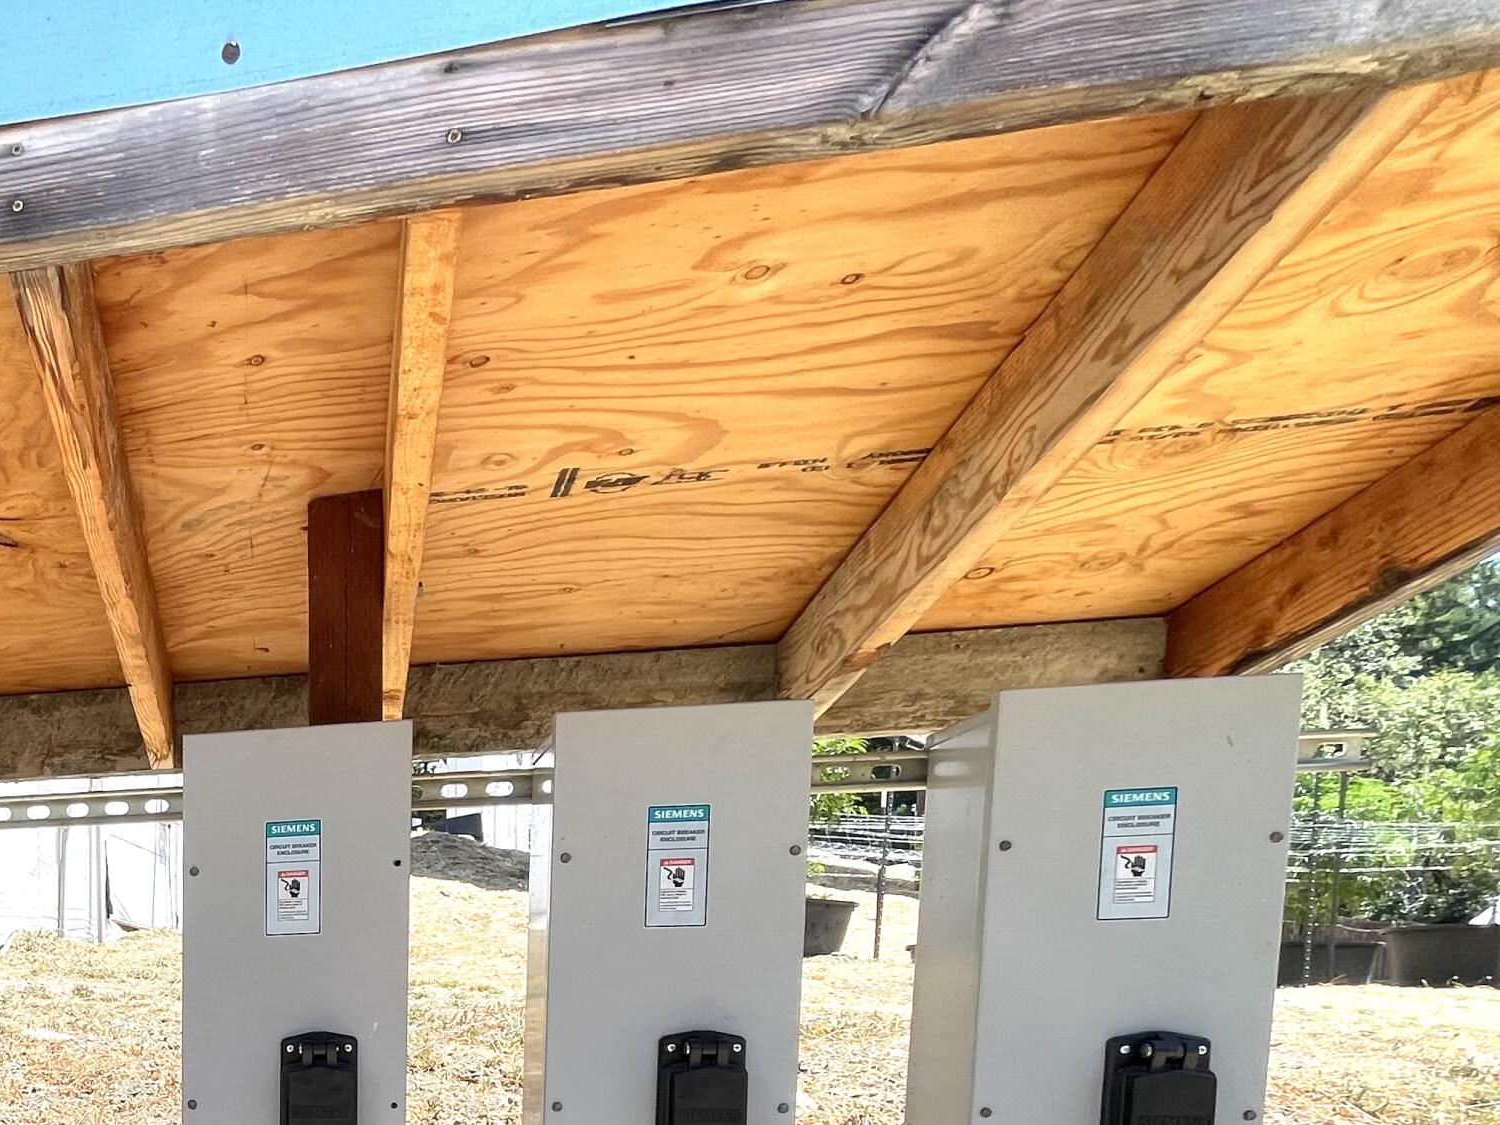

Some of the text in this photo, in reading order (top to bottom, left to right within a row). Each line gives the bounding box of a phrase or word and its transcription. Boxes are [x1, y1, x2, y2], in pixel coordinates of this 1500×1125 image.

[1111, 791, 1170, 803] SIEMENS
[654, 808, 704, 819] SIEMENS
[271, 823, 316, 834] SIEMENS
[269, 843, 291, 851] CIRCUIT
